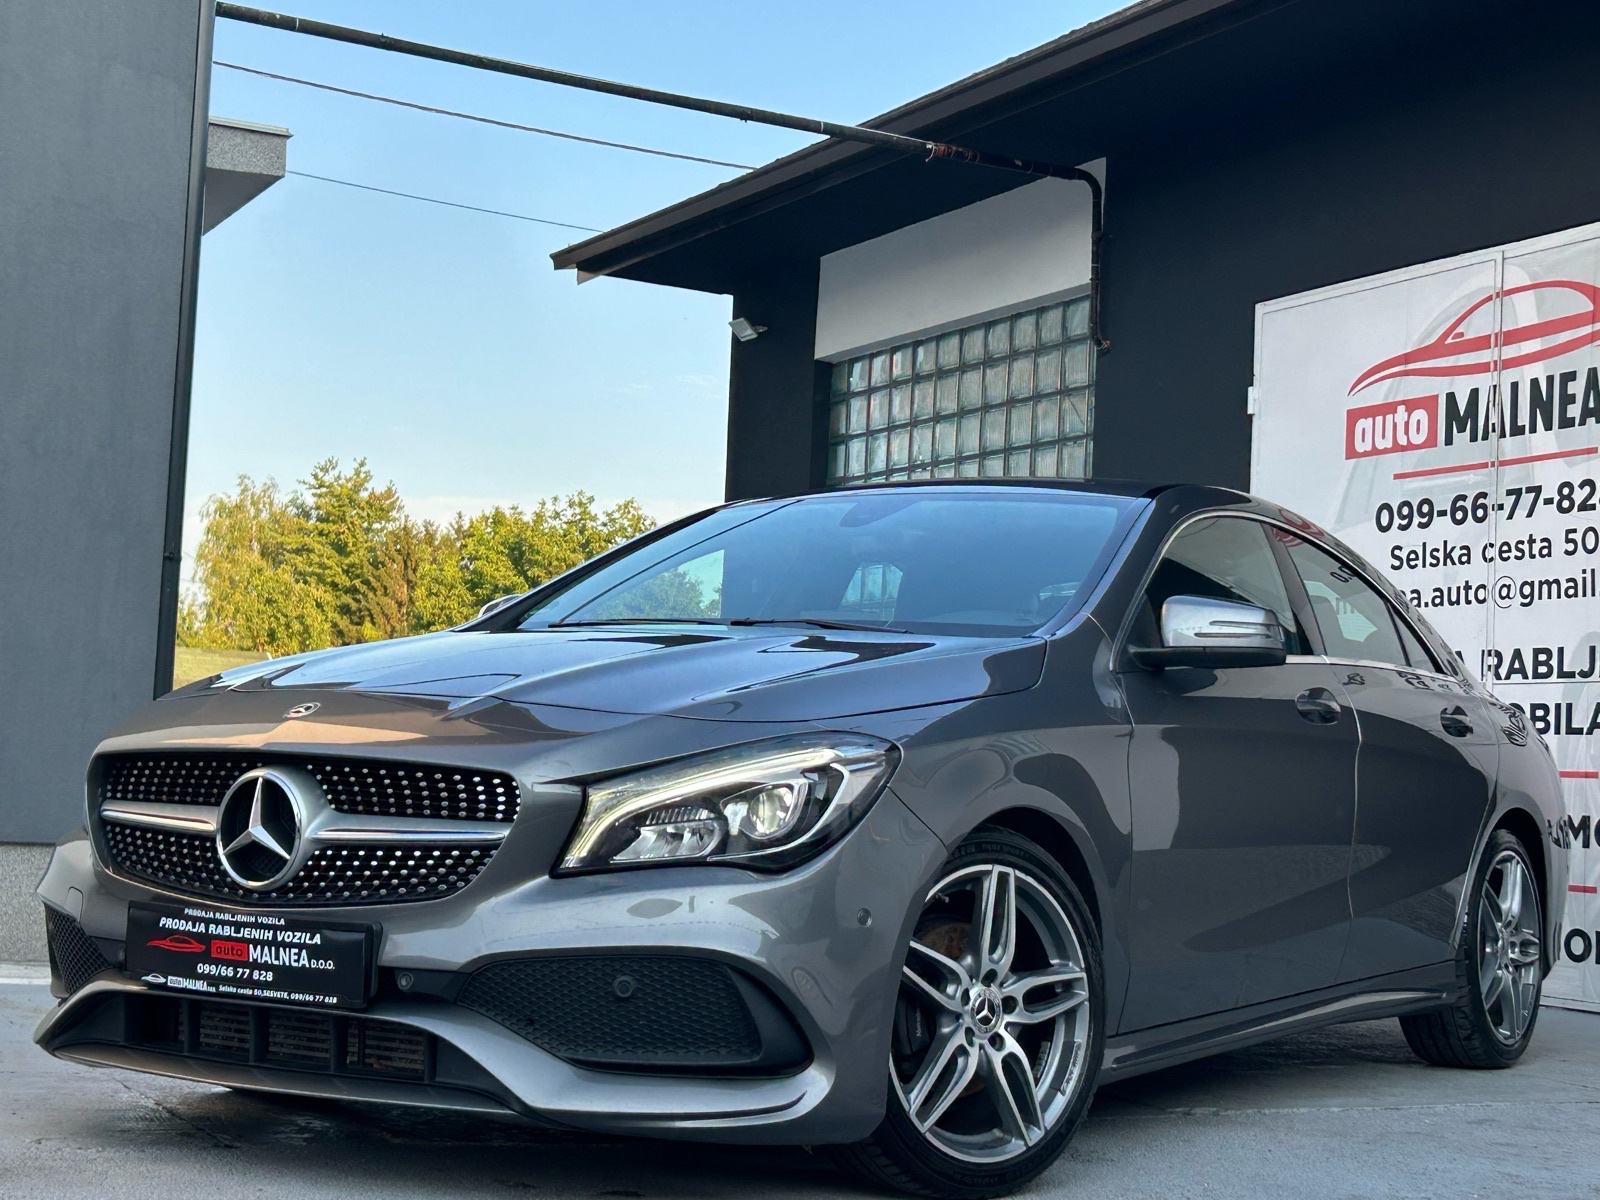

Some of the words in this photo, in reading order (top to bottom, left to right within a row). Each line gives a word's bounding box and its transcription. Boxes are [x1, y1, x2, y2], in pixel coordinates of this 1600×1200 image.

[1354, 405, 1429, 453] auto
[1444, 366, 1600, 446] MALNEA
[1375, 478, 1600, 533] 099-66-77-82
[1390, 540, 1472, 570] Selska
[1481, 533, 1552, 563] cesta
[1563, 526, 1600, 556] 50
[1400, 568, 1600, 609] a.auto@gmail
[1481, 645, 1600, 682] RABLJ
[1509, 702, 1600, 736] BILA
[159, 916, 206, 933] PRODAJA
[208, 923, 273, 941] RABLJENIH
[277, 930, 321, 944] VOZILA
[184, 907, 214, 919] PRODAJA
[215, 912, 255, 923] RABLJENIH
[257, 915, 285, 925] VOZILA
[197, 963, 234, 977] 099/66
[236, 968, 249, 979] 77
[252, 969, 273, 981] 828
[215, 946, 244, 957] auto
[249, 943, 310, 968] MALNEA
[310, 959, 336, 970] D.O.O.
